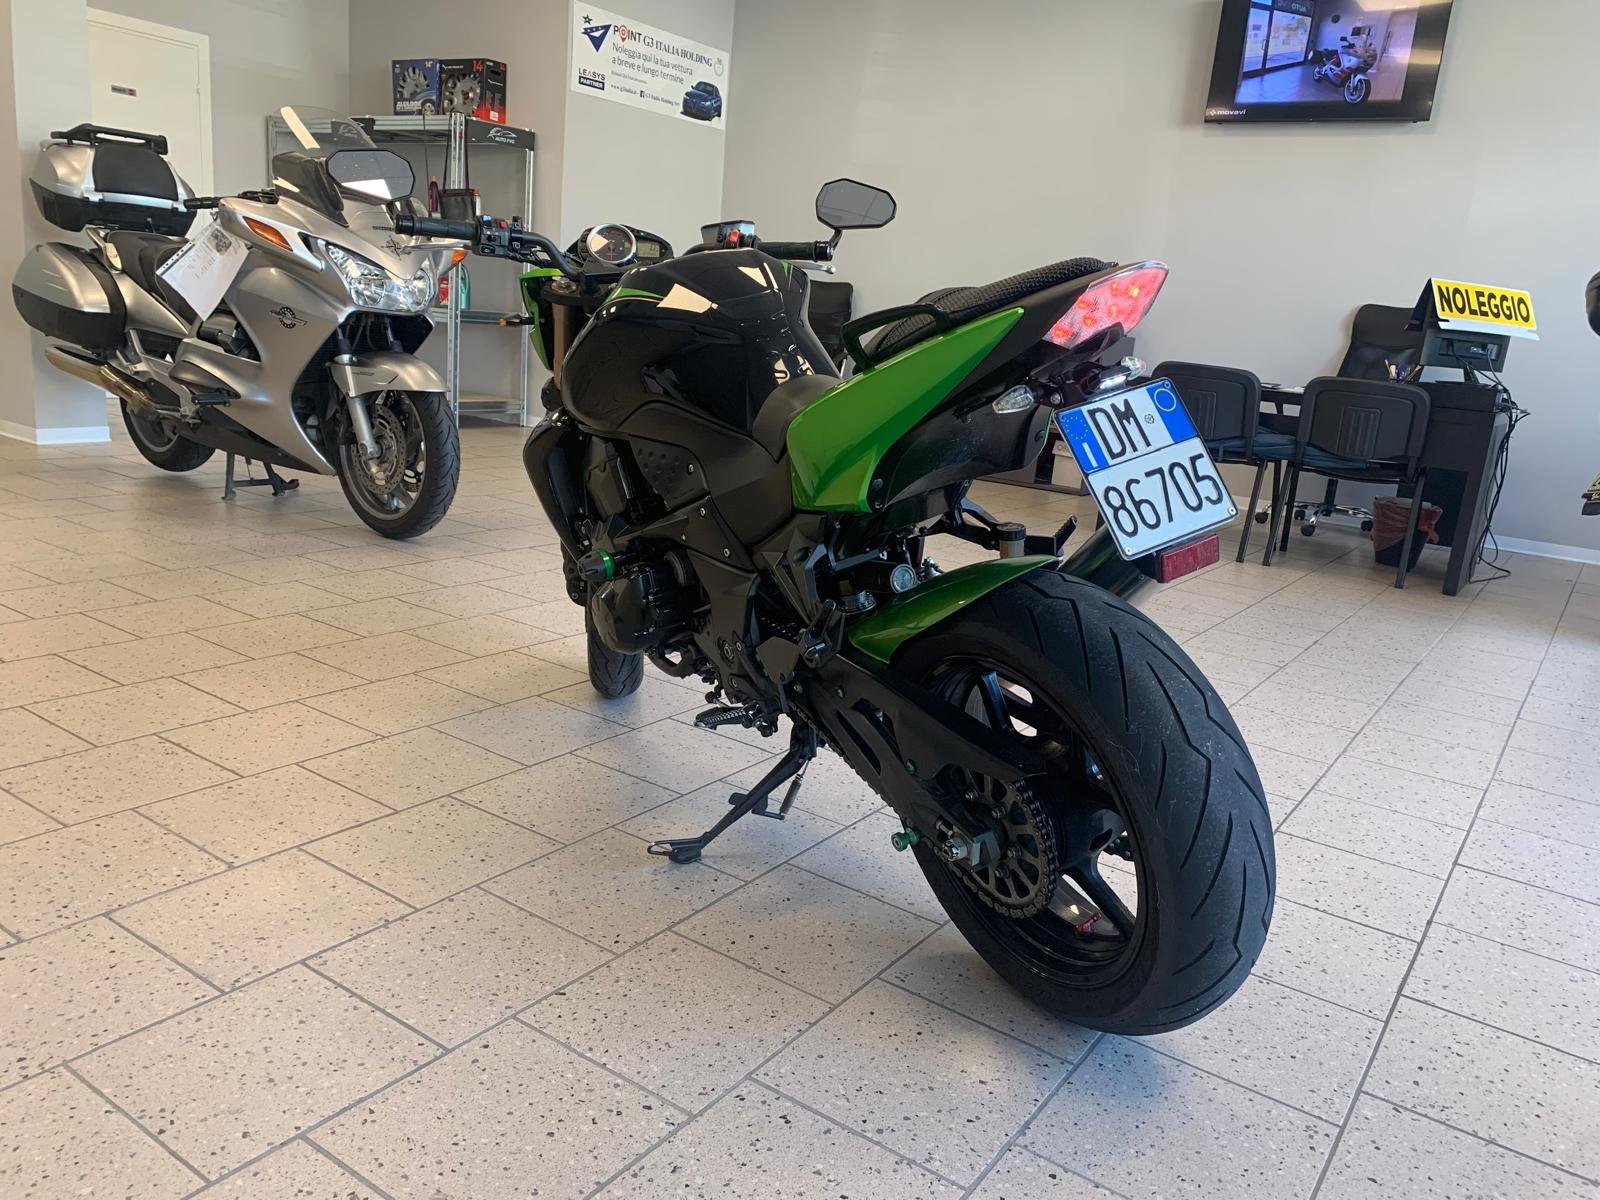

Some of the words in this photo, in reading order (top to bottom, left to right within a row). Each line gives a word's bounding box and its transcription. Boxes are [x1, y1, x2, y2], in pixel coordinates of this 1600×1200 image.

[612, 42, 641, 60] Noleggia
[642, 53, 652, 63] qui
[653, 54, 659, 65] la
[660, 58, 670, 68] tua
[671, 62, 693, 75] vettura
[613, 25, 643, 43] POINT
[643, 35, 654, 48] G3
[656, 40, 679, 56] ITALIA
[681, 49, 713, 67] HOLDING
[473, 60, 483, 72] 14
[579, 67, 606, 81] LEASYS
[617, 56, 636, 71] breve
[637, 64, 641, 72] e
[642, 63, 660, 78] lungo
[660, 69, 684, 84] termine
[580, 77, 604, 89] PARTNER
[1437, 285, 1530, 323] NOLEGGIO
[1087, 398, 1152, 461] DM
[1082, 442, 1099, 468] I
[1103, 453, 1224, 538] 86705
